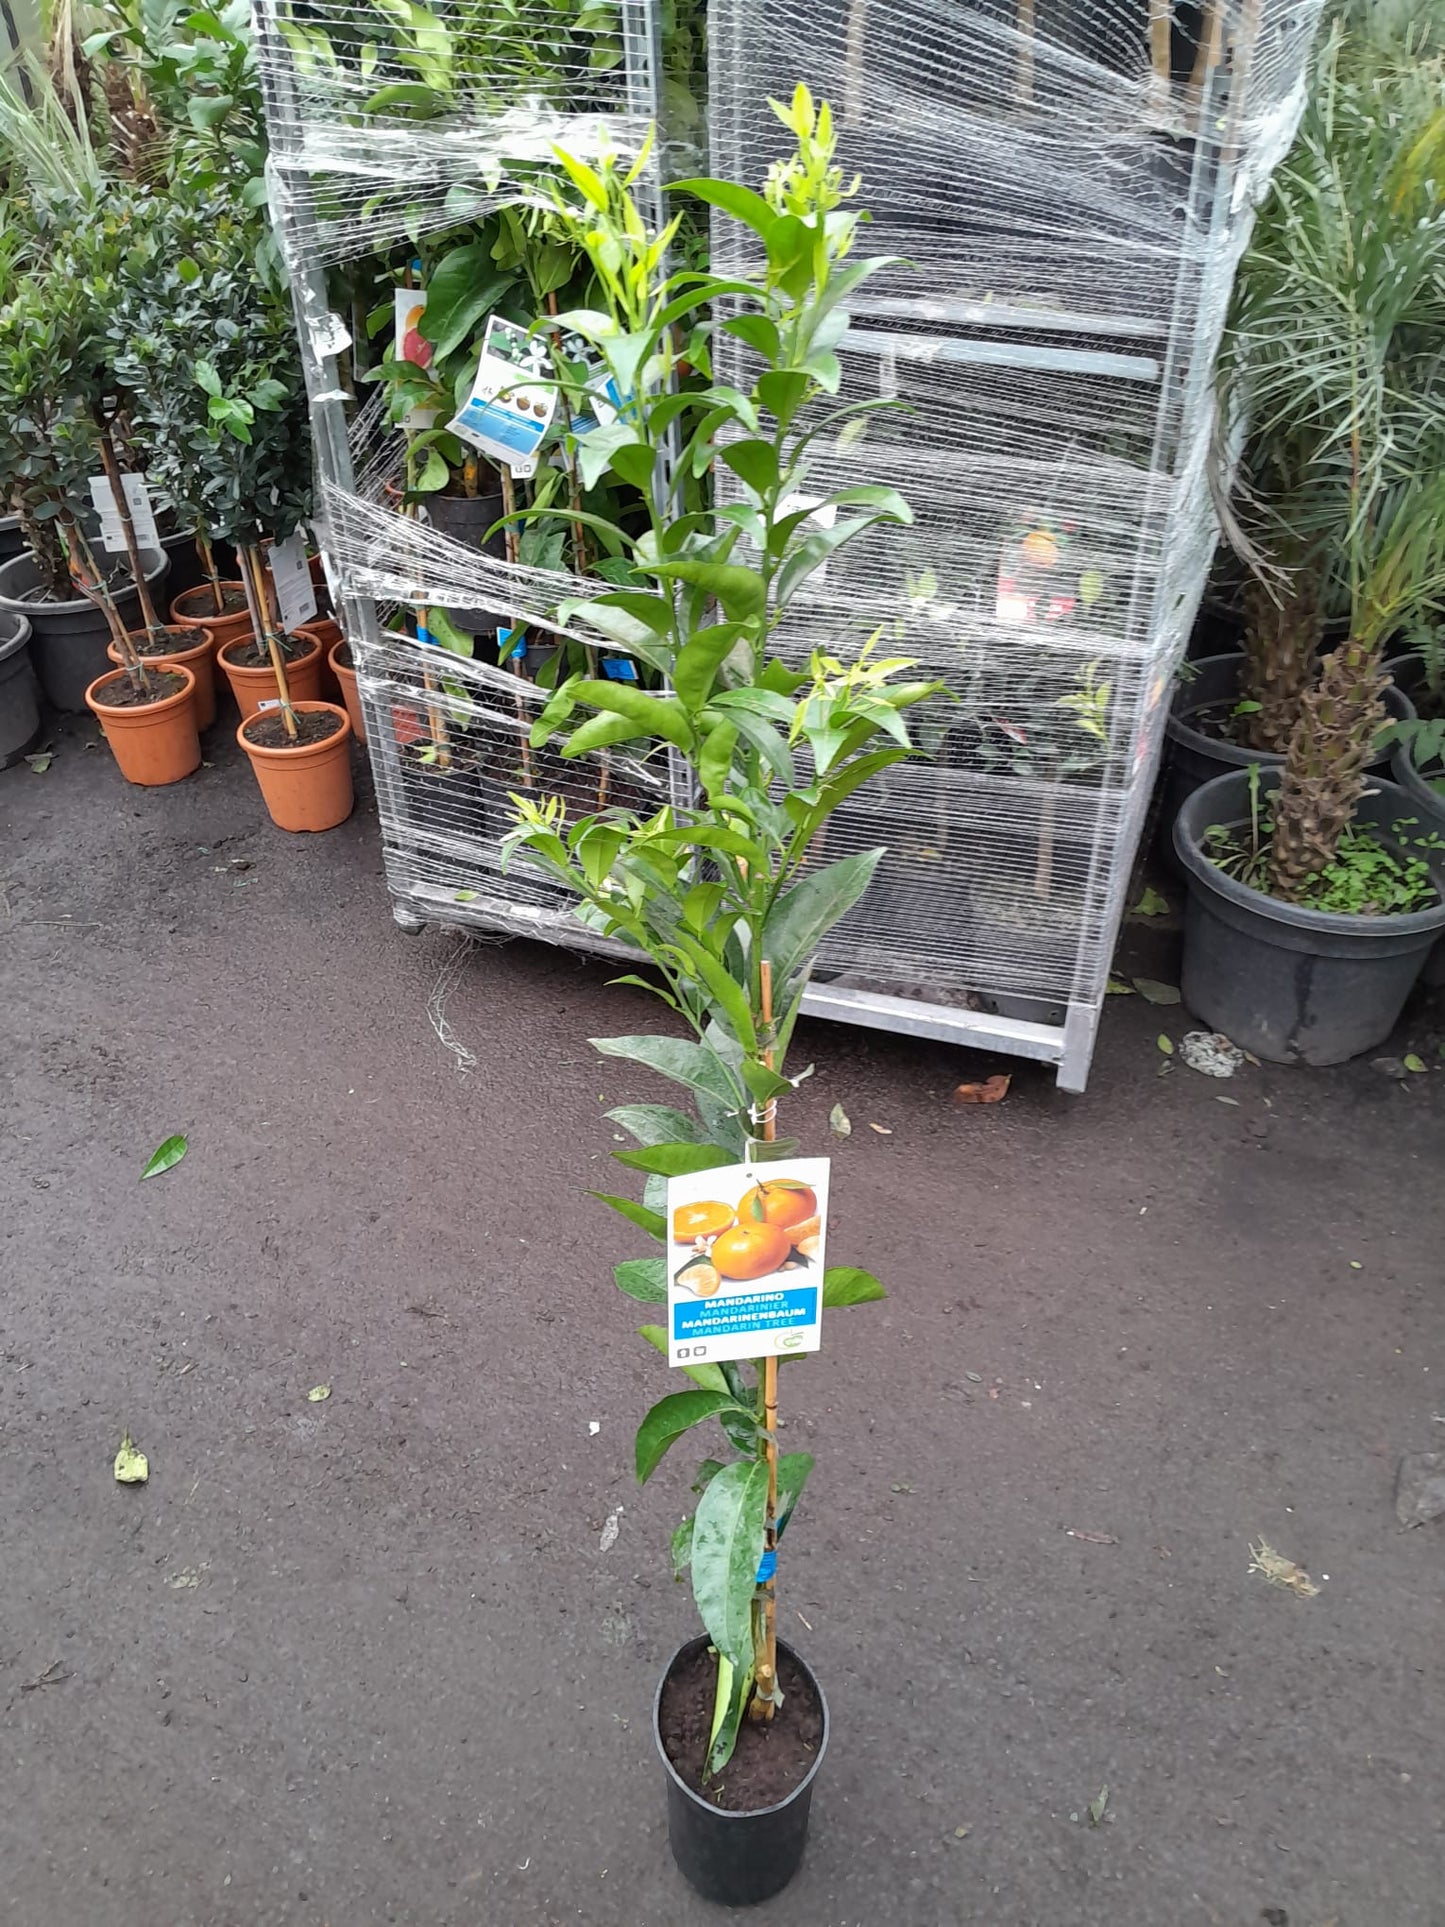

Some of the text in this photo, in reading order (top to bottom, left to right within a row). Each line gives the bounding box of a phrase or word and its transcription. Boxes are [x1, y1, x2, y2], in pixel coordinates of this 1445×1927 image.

[700, 1301, 788, 1318] MANDARINIER
[705, 1293, 784, 1309] MANDARINO
[682, 1308, 806, 1328] MANDARINENBAUM
[692, 1318, 796, 1336] MANDARIN TREE
